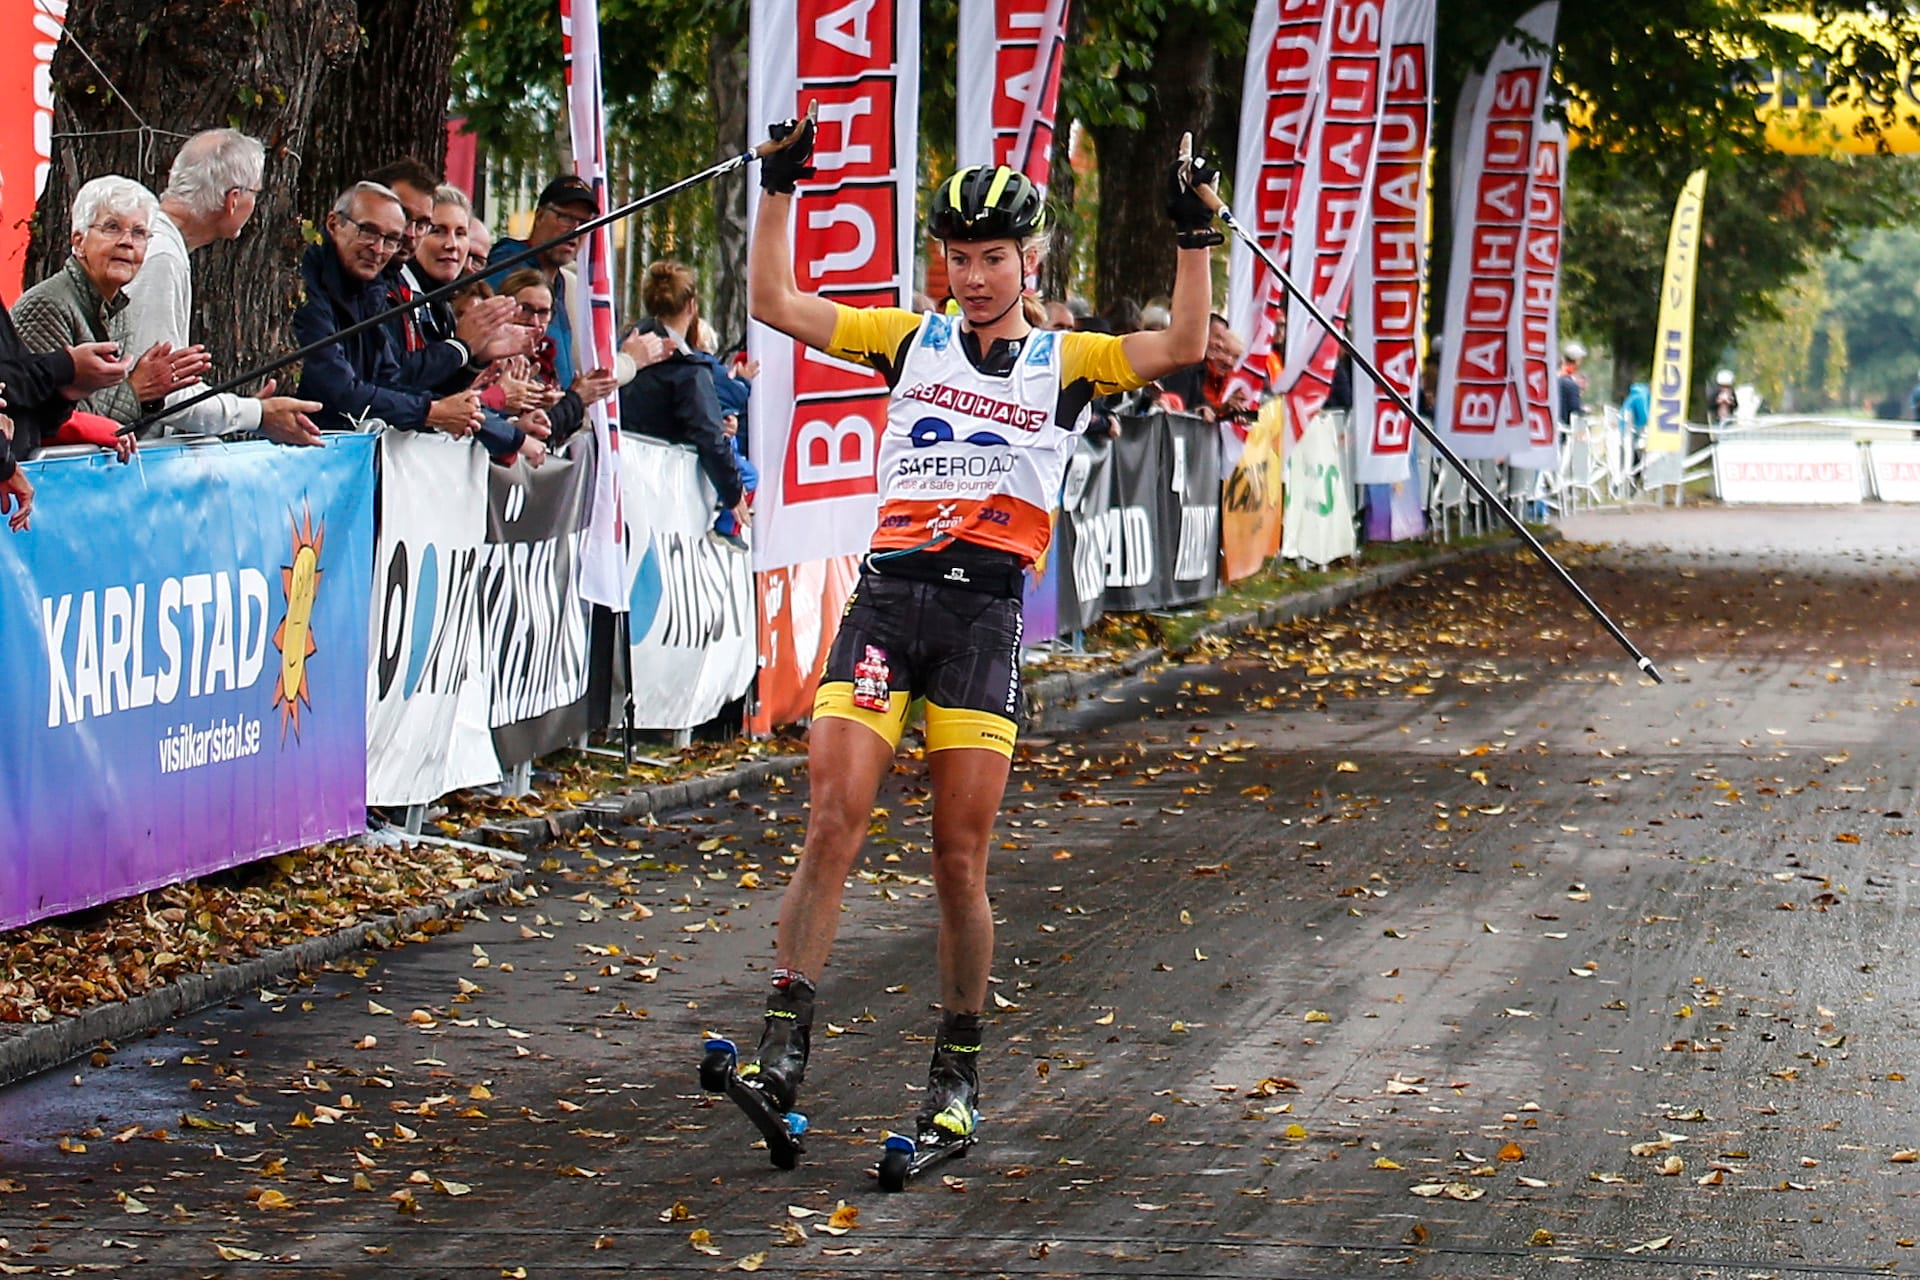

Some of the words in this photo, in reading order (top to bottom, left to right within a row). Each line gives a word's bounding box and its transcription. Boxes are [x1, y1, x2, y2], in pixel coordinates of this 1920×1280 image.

[796, 0, 876, 485] BUHA
[1376, 53, 1420, 446] BAUHAUS
[1460, 77, 1531, 427] BAUHAUS
[917, 385, 1047, 431] BAUHAUS
[929, 479, 954, 491] safe
[956, 479, 998, 492] journe
[1725, 463, 1853, 481] BAUHAUS
[41, 566, 270, 728] KARLSTAD
[159, 712, 261, 774] visitkarlstad.se
